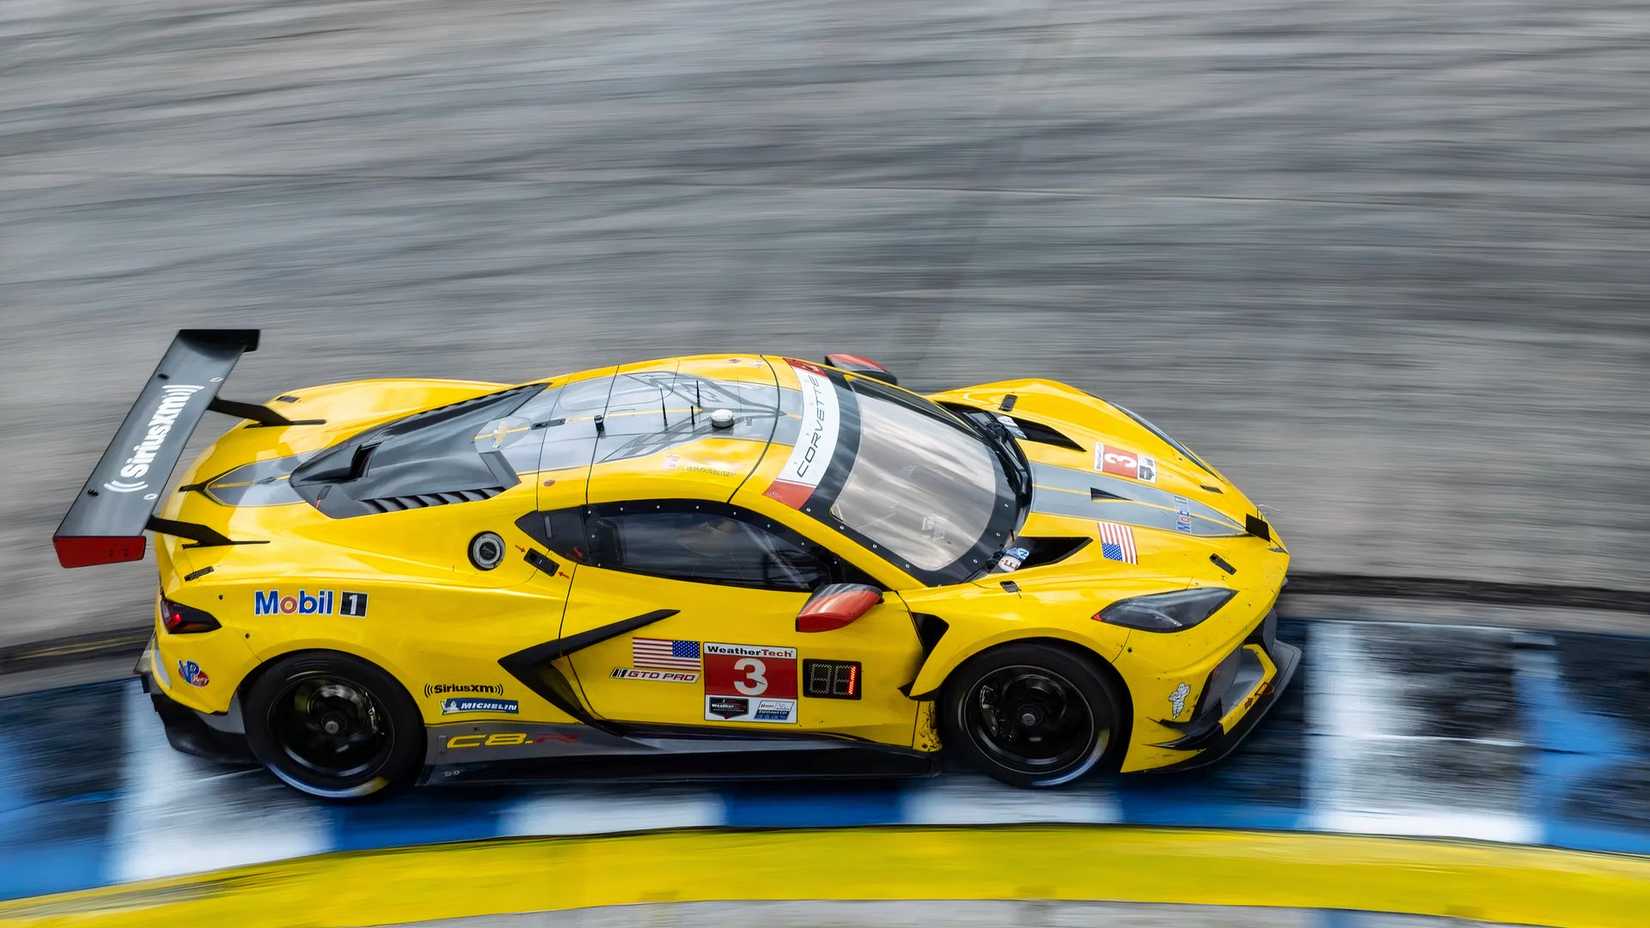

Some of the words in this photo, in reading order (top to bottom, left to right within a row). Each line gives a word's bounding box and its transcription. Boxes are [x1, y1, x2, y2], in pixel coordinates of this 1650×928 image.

[796, 374, 826, 478] CORVETTE
[1103, 453, 1137, 468] 3
[255, 590, 333, 615] Mobil
[707, 645, 792, 657] WeatherTech
[663, 672, 696, 681] PRO
[734, 658, 768, 696] 3
[461, 702, 518, 711] MICHELIN
